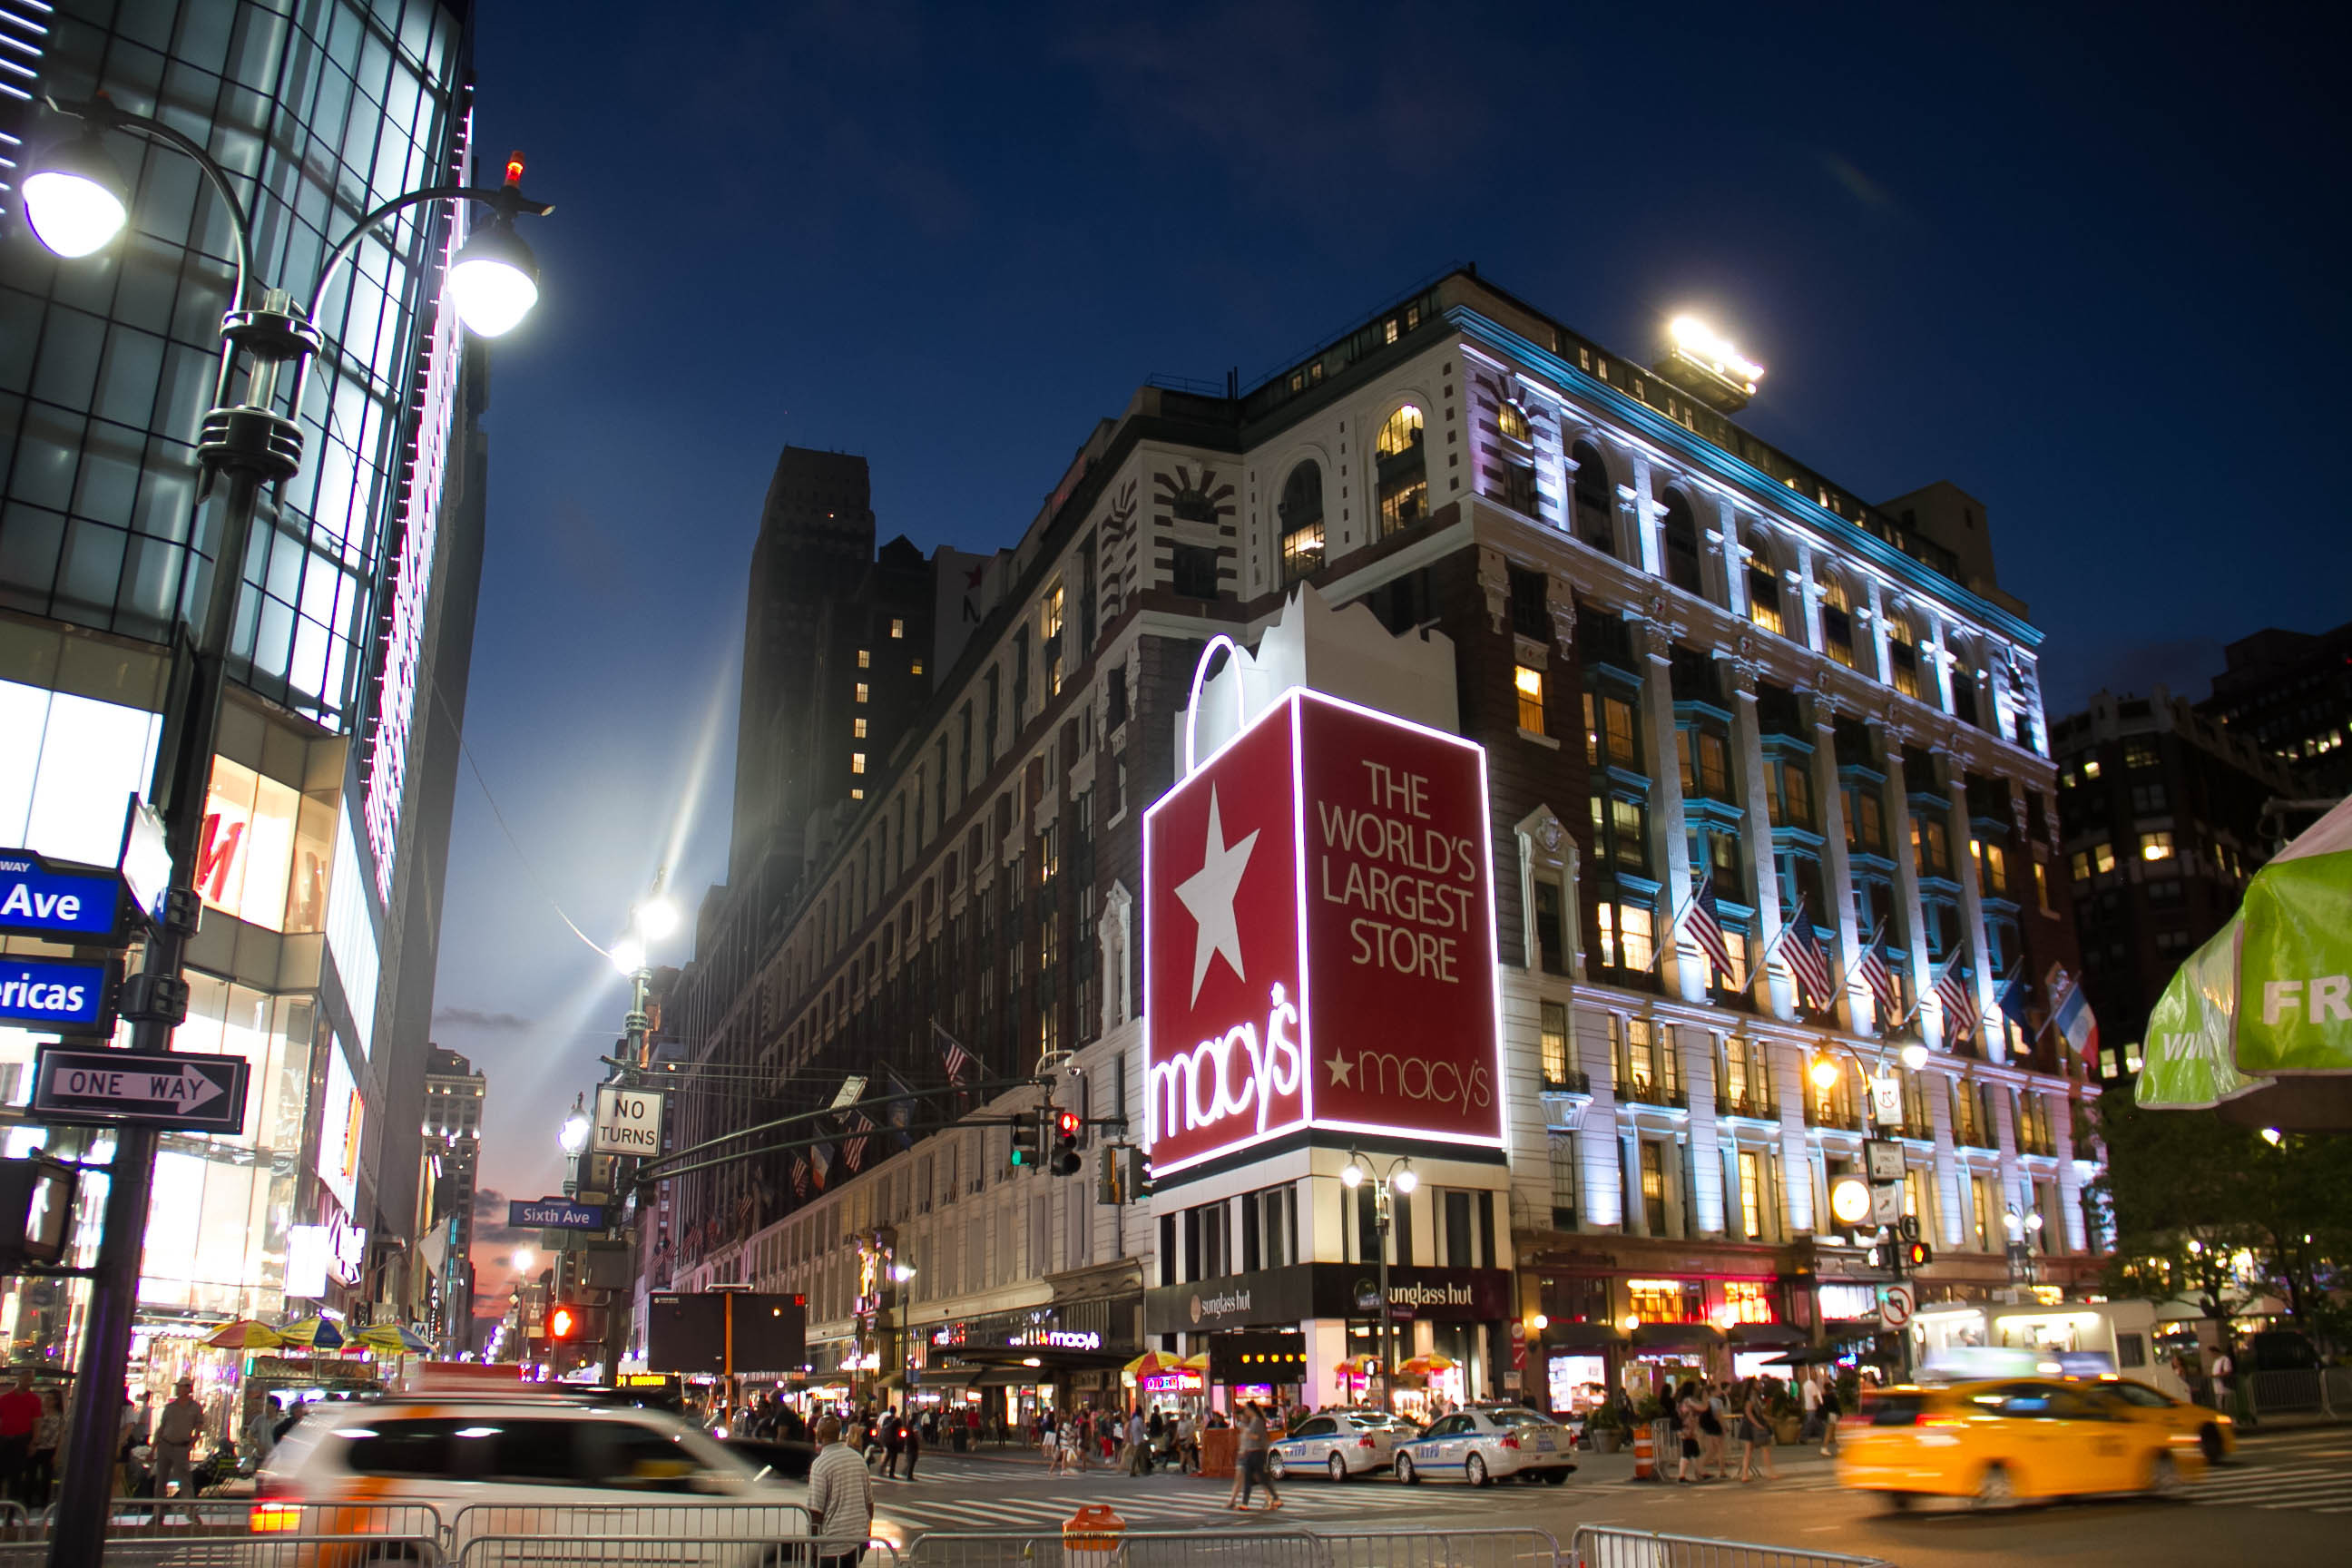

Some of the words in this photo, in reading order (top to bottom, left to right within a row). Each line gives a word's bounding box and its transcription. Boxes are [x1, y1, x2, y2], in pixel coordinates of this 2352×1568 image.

[1362, 760, 1431, 820] THE
[1318, 800, 1476, 882] WORLD'S
[0, 883, 81, 921] Ave
[1322, 856, 1475, 933] LARGEST
[1349, 918, 1459, 984] STORE
[0, 973, 85, 1012] ricas
[1150, 981, 1301, 1144] macy's
[69, 1071, 123, 1095] ONE
[151, 1076, 204, 1101] WAY
[1359, 1050, 1490, 1115] macy's
[614, 1099, 644, 1119] NO
[600, 1126, 655, 1145] TURNS
[524, 1208, 559, 1222] Sixth
[563, 1210, 590, 1224] Ave
[1201, 1291, 1235, 1319] sunglass
[1236, 1289, 1250, 1310] hut
[1388, 1281, 1446, 1309] unglass
[1448, 1282, 1474, 1305] hut
[1050, 1331, 1101, 1350] macy's
